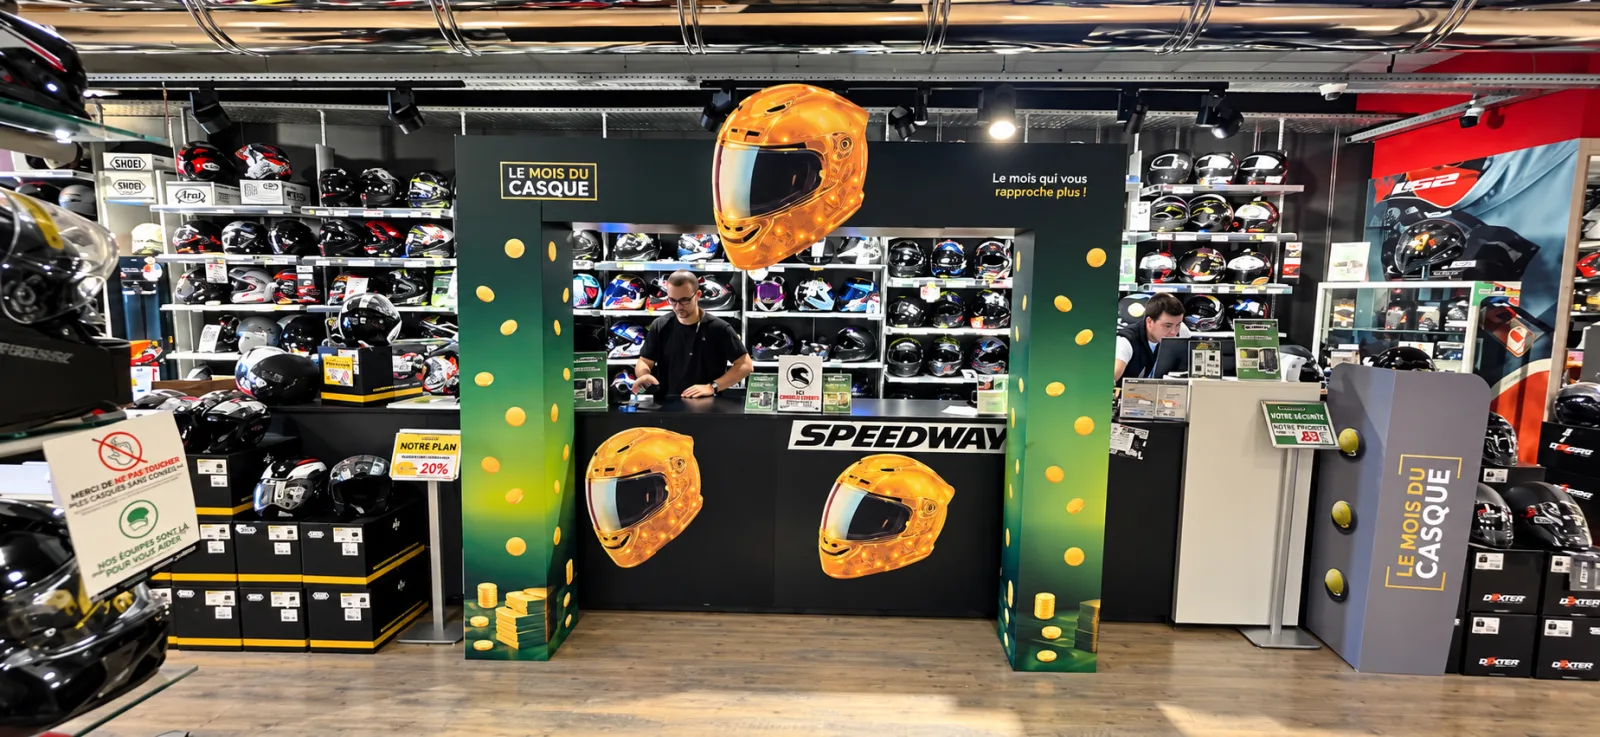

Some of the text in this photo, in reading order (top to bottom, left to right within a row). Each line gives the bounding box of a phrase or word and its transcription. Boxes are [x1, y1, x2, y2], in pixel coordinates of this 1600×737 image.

[115, 159, 142, 169] SHOEI
[509, 167, 589, 179] LE MOIS DU
[992, 172, 1088, 186] Le mois qui vous
[117, 181, 142, 191] SHOEI
[508, 180, 589, 197] CASQUE
[1391, 172, 1460, 196] LS2
[181, 190, 201, 199] Arai
[995, 186, 1087, 199] rapproche plus !
[794, 423, 1007, 450] SPEEDWAY
[400, 442, 457, 451] NOTRE PLAN
[420, 462, 449, 475] 20%
[70, 484, 100, 501] MERCI
[101, 480, 113, 490] DE
[114, 475, 126, 485] NE
[127, 468, 144, 481] PAS
[144, 456, 181, 473] TOUCHER
[89, 484, 126, 503] CASQUES
[127, 477, 148, 489] SANS
[1396, 467, 1426, 577] LE MOIS DU
[1415, 468, 1451, 579] CASQUE
[97, 555, 118, 570] NOS
[118, 537, 155, 560] ÉQUIPES
[155, 527, 177, 543] SONT
[105, 559, 131, 577] POUR
[132, 547, 156, 563] VOUS
[158, 535, 182, 552] AIDER
[1482, 593, 1526, 603] DEXTER
[1559, 596, 1600, 607] DEXTER
[1479, 657, 1520, 666] DEXTER
[1551, 659, 1594, 669] DEXTER
